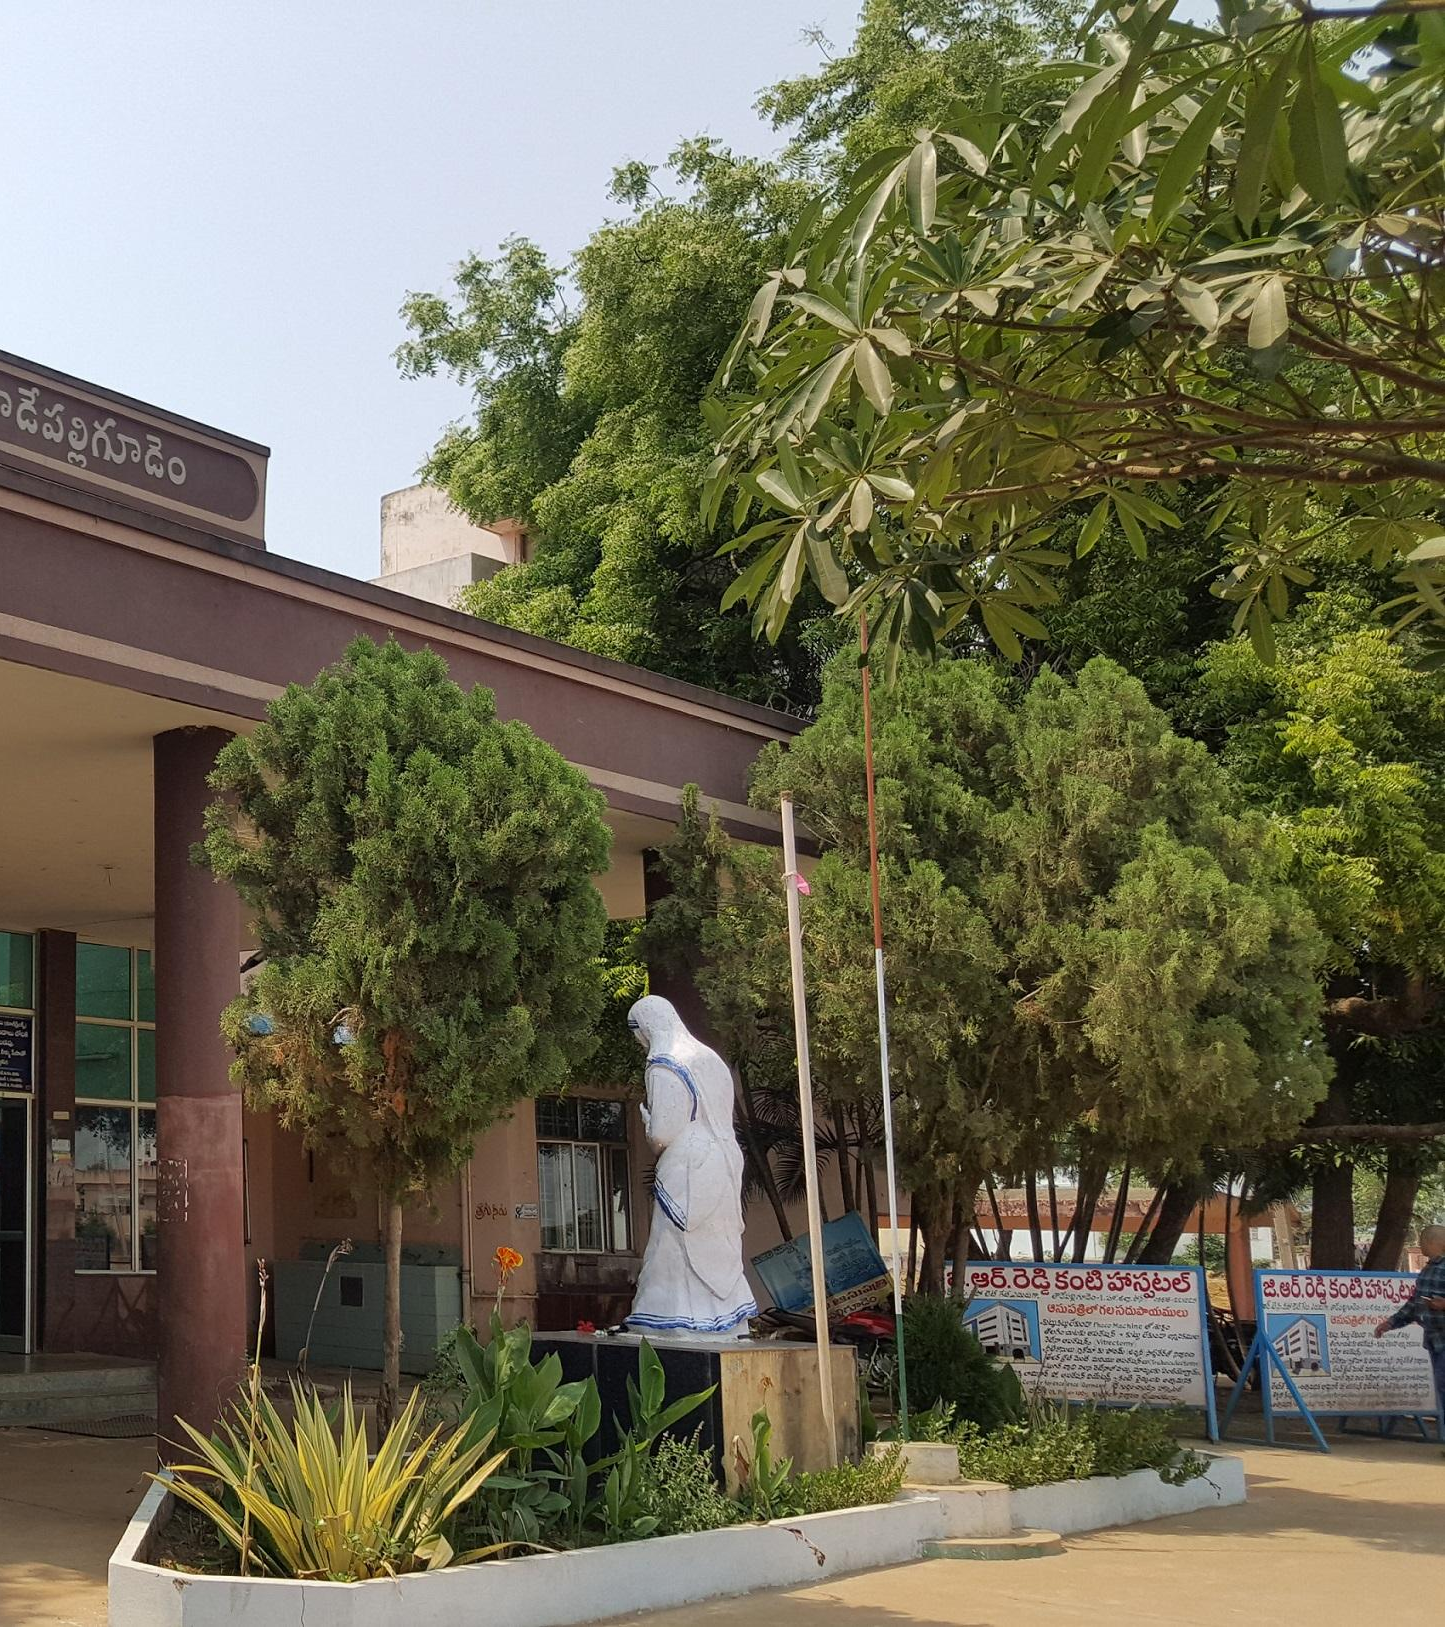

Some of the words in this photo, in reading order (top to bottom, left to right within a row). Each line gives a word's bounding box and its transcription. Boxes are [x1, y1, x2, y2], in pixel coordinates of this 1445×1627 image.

[1054, 1269, 1103, 1291] కంటి
[1262, 1274, 1327, 1305] జి.ఆర్.రెడ్డి
[1328, 1276, 1364, 1299] కంటి
[1047, 1303, 1098, 1317] ఆసుపత్రిలో
